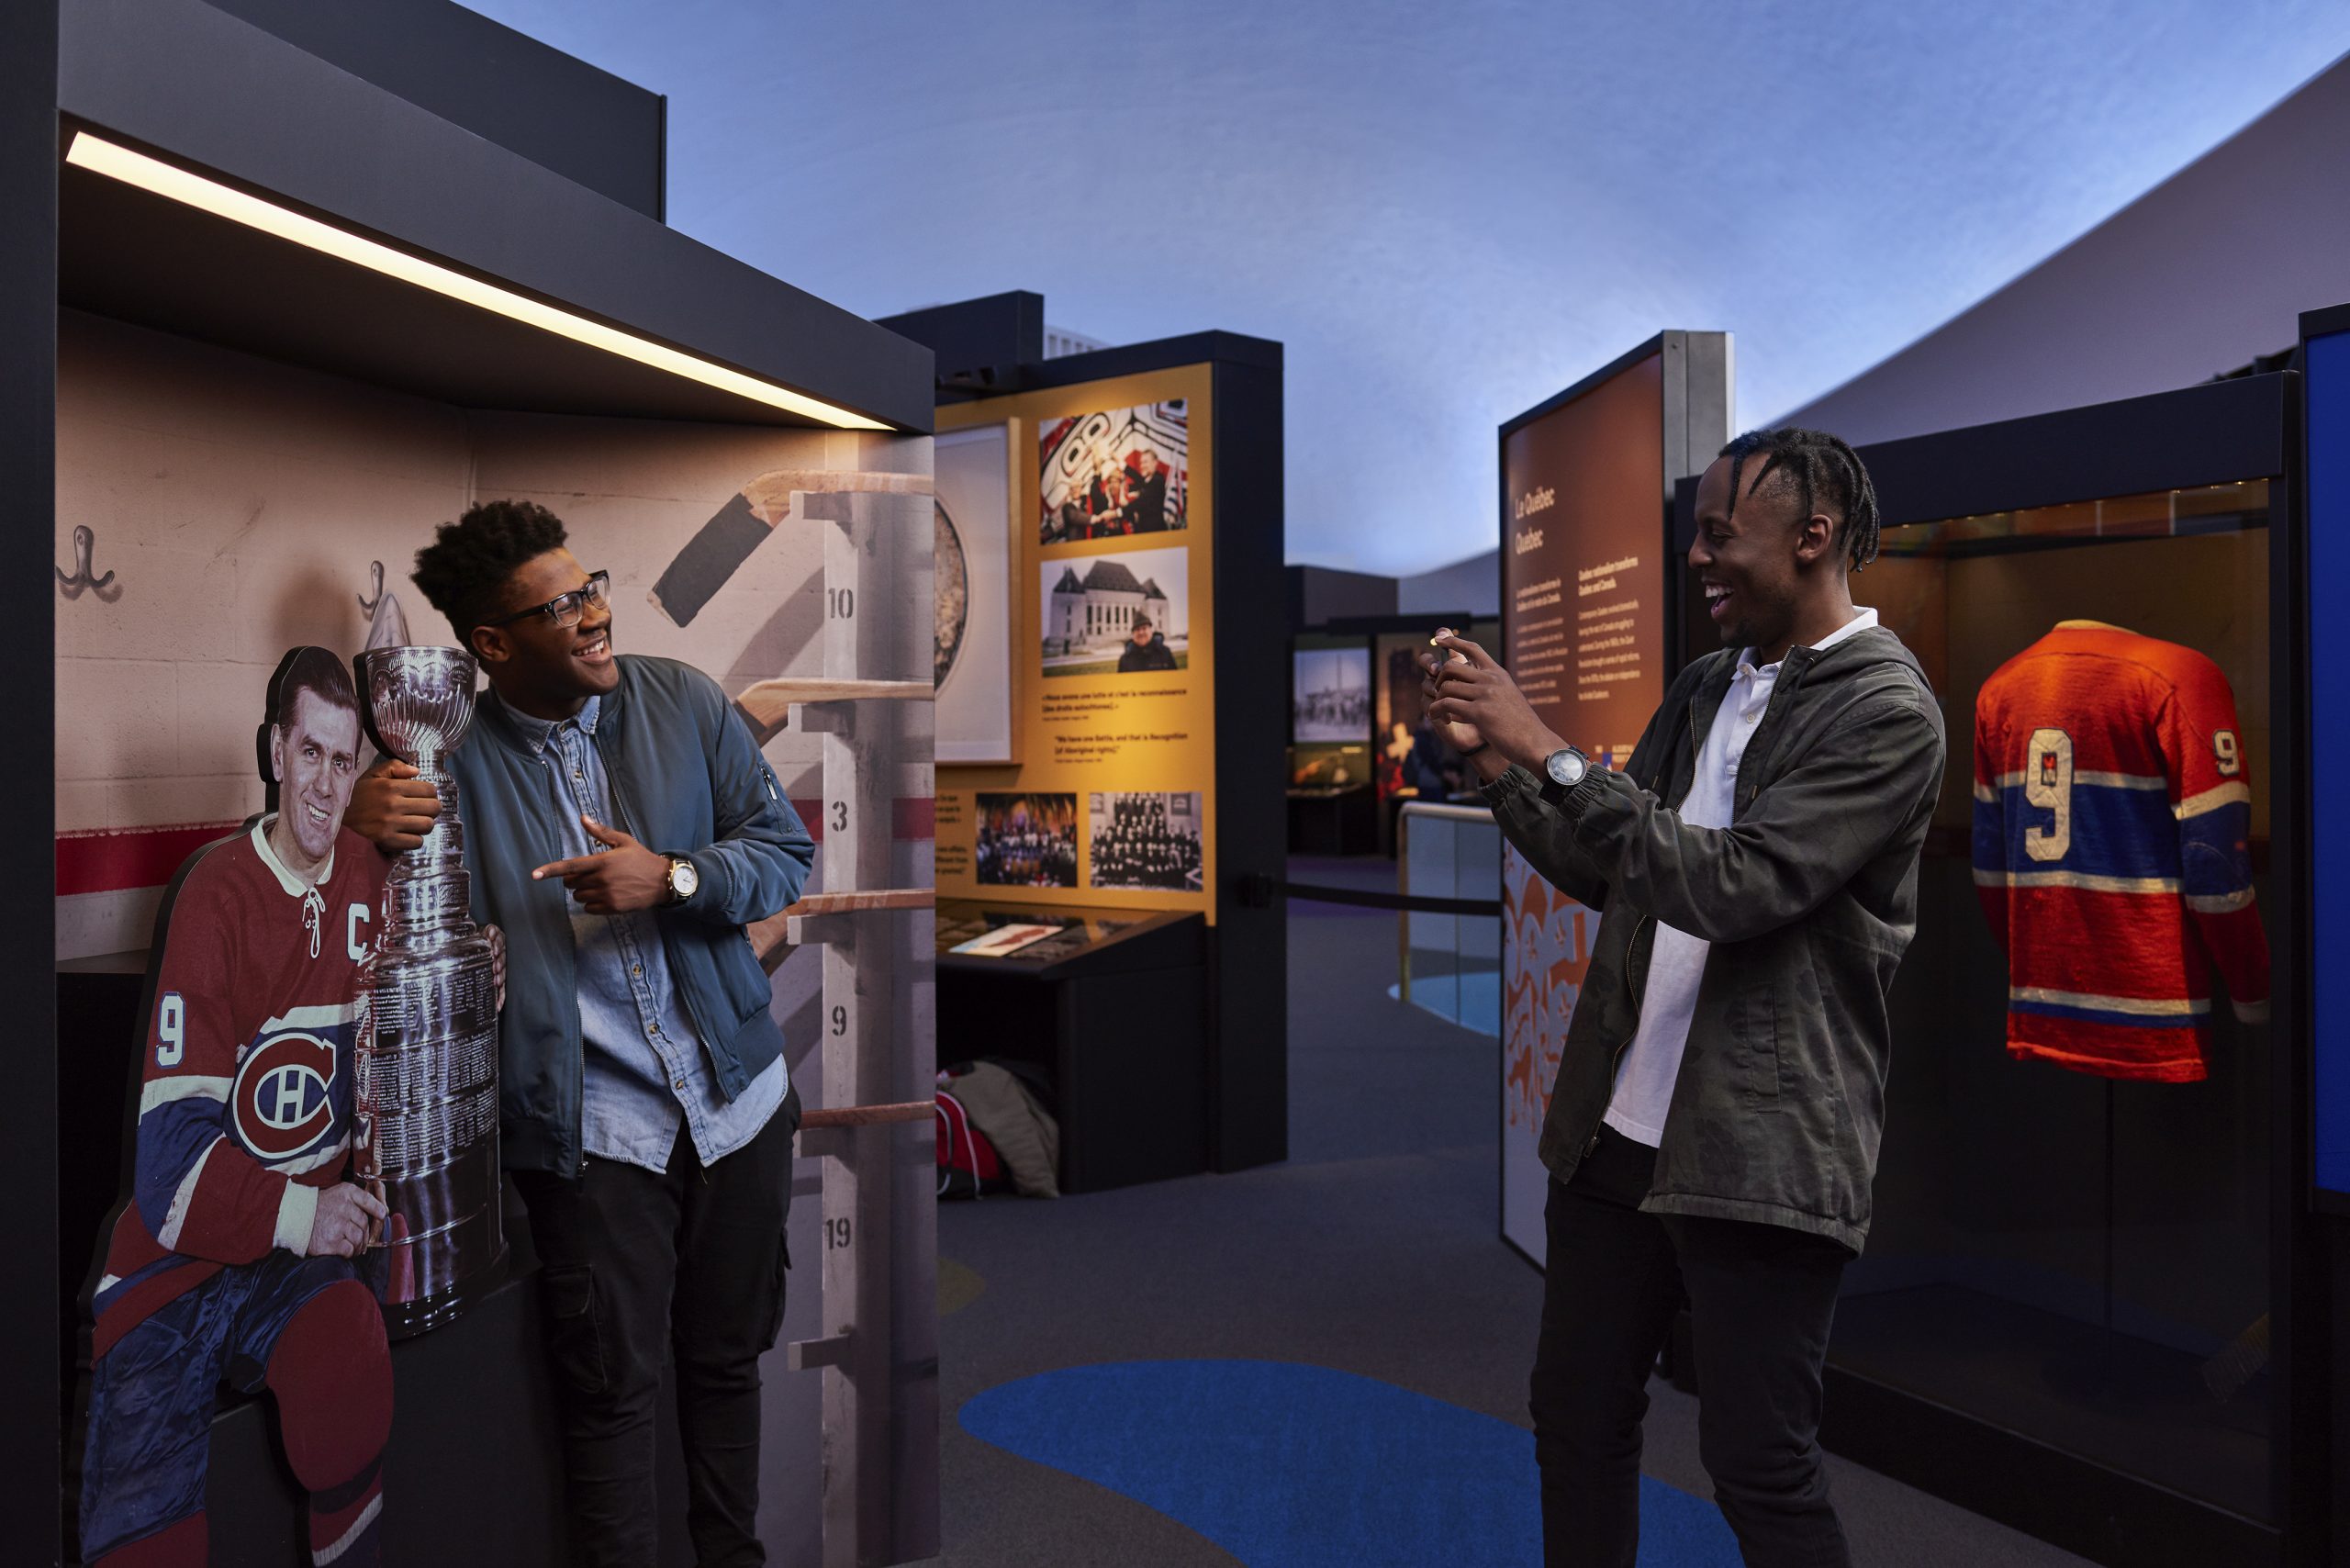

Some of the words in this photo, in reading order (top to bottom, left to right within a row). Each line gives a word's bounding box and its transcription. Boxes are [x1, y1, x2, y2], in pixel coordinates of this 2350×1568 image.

[827, 588, 854, 620] 10
[2211, 729, 2241, 777] 9
[2024, 727, 2074, 862] 9
[832, 801, 848, 832] 3
[348, 902, 369, 960] C
[154, 991, 185, 1069] 9
[832, 1004, 847, 1036] 9
[825, 1217, 851, 1250] 19
